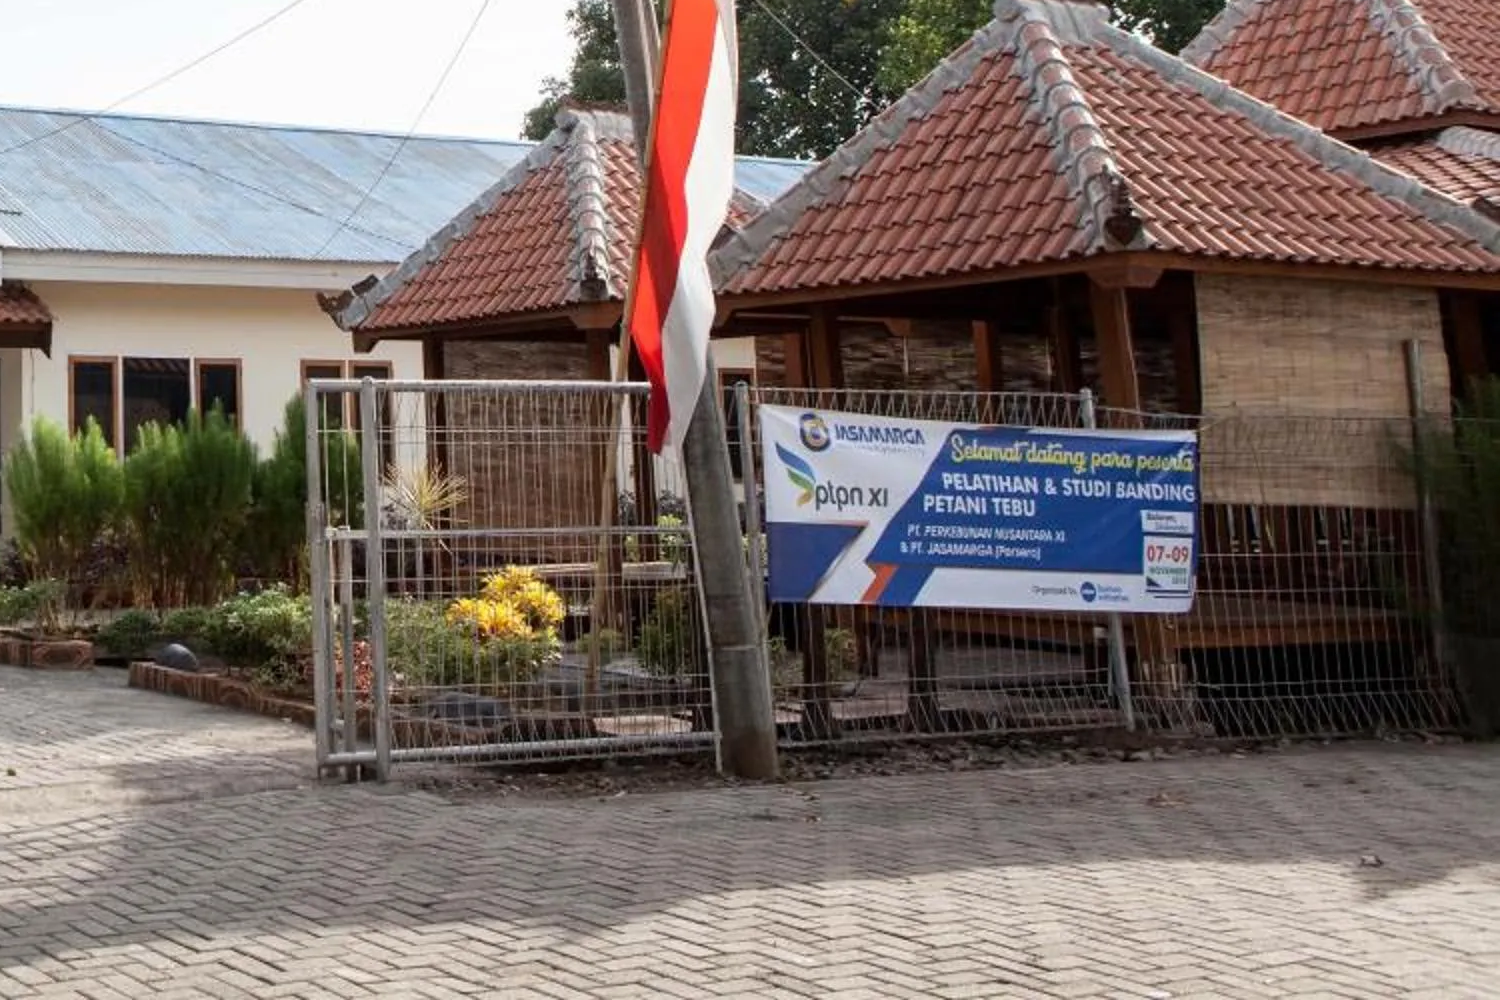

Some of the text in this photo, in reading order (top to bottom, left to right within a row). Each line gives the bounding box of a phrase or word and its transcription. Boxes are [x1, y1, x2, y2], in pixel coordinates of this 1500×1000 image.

[835, 423, 926, 445] JASAMARGA
[950, 433, 1028, 463] Selamat
[1026, 440, 1088, 475] datang
[1091, 450, 1132, 475] para
[1135, 444, 1194, 478] peserta
[815, 480, 864, 511] ptpn
[941, 472, 1196, 503] PELATIHAN & STUDI BANDING
[923, 494, 1036, 517] PETANI TEBU
[924, 525, 993, 540] PERKEBUNAN
[994, 528, 1053, 542] NUSANTARA
[1147, 545, 1189, 563] 07-09
